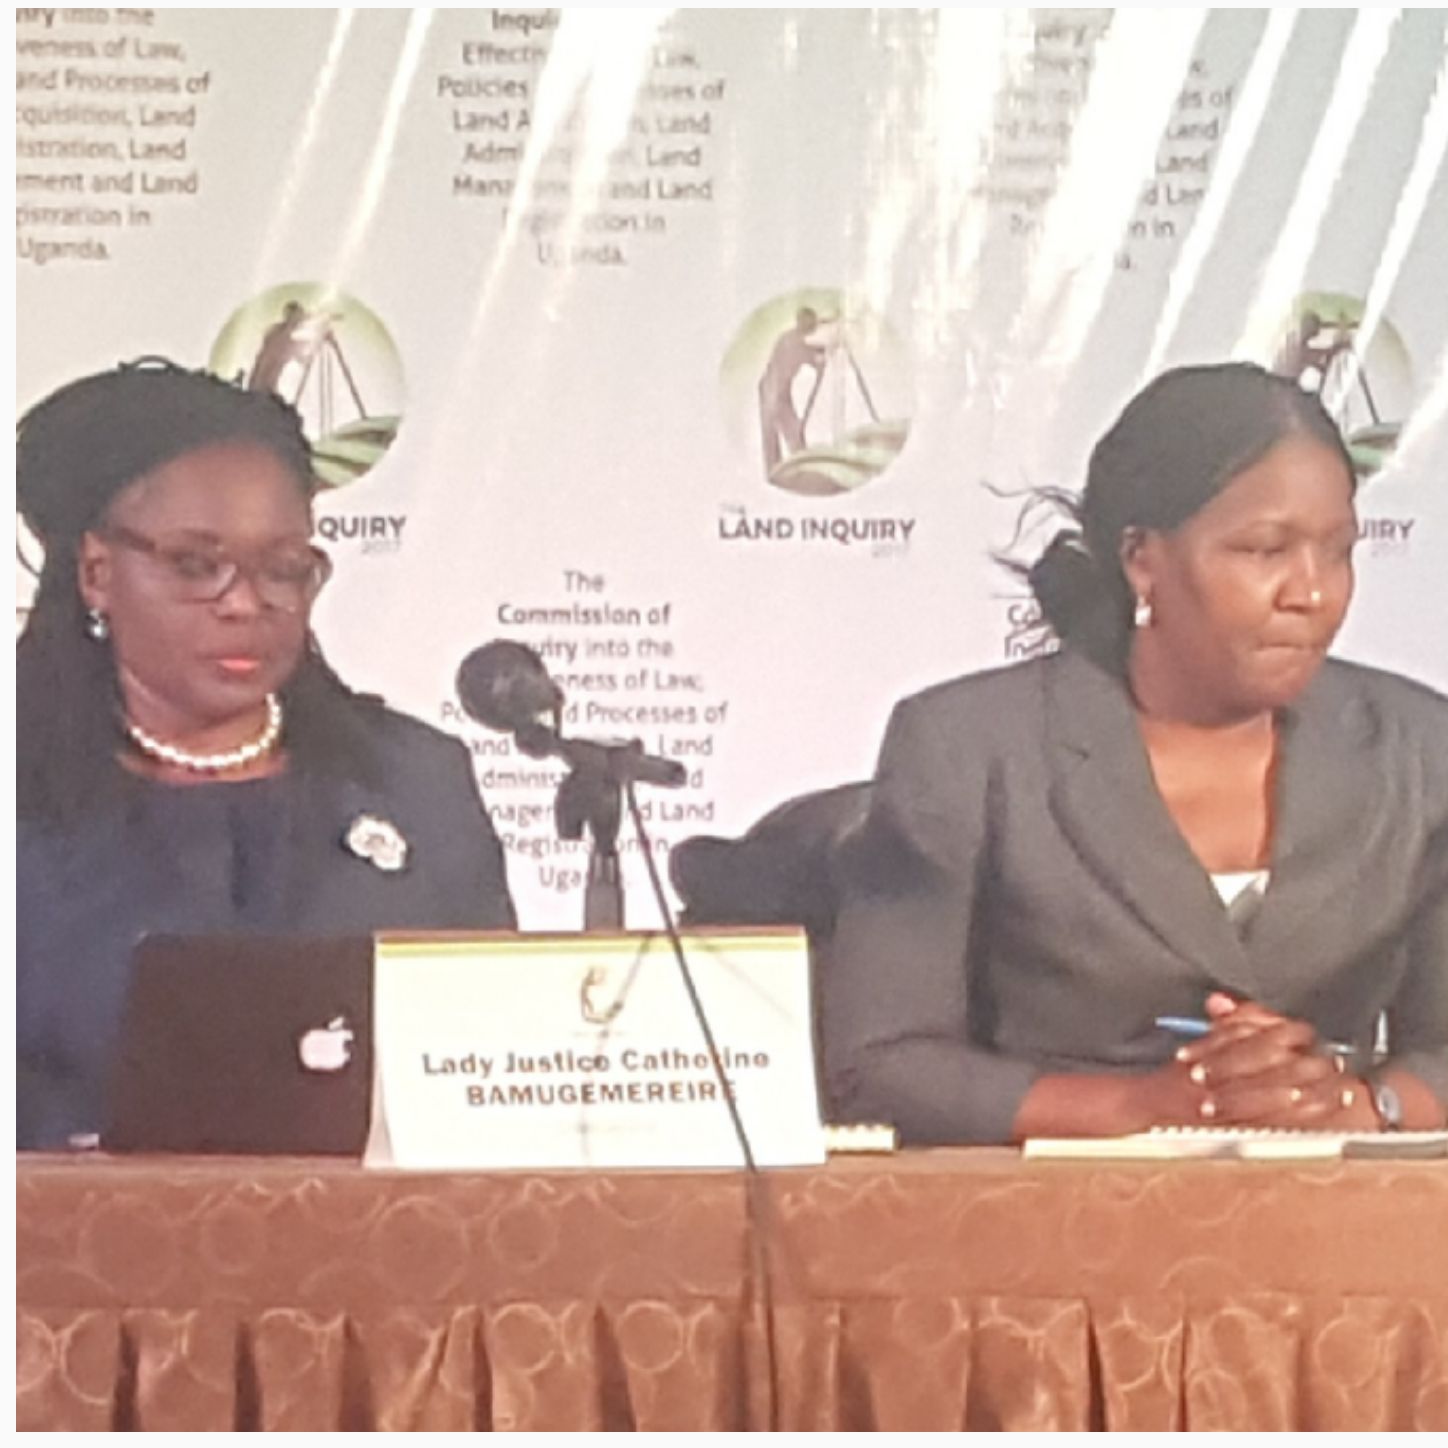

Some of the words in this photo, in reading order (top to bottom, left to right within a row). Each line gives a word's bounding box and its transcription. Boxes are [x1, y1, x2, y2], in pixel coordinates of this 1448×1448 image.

[104, 36, 127, 58] of
[64, 68, 182, 94] Processes
[186, 71, 210, 95] of
[437, 74, 529, 100] Policies
[701, 79, 726, 101] of
[16, 105, 132, 130] quisition,
[140, 105, 197, 128] Land
[452, 108, 510, 132] Land
[129, 138, 187, 161] Land
[645, 145, 701, 168] Land
[92, 172, 134, 194] and
[141, 171, 198, 195] Land
[657, 179, 713, 201] Land
[129, 205, 151, 226] in
[318, 515, 407, 543] QUIRY
[718, 517, 795, 540] LAND
[800, 518, 916, 546] INQUIRY
[563, 570, 605, 594] The
[497, 604, 641, 626] Commission
[647, 603, 672, 626] of
[585, 638, 631, 658] into
[637, 637, 675, 658] the
[624, 668, 648, 691] of
[586, 702, 698, 725] Processes
[704, 701, 729, 725] of
[471, 737, 511, 756] and
[659, 735, 714, 756] Land
[660, 801, 715, 822] Land
[423, 1051, 494, 1077] Lady
[504, 1048, 611, 1074] Justice
[620, 1048, 771, 1072] Catheine
